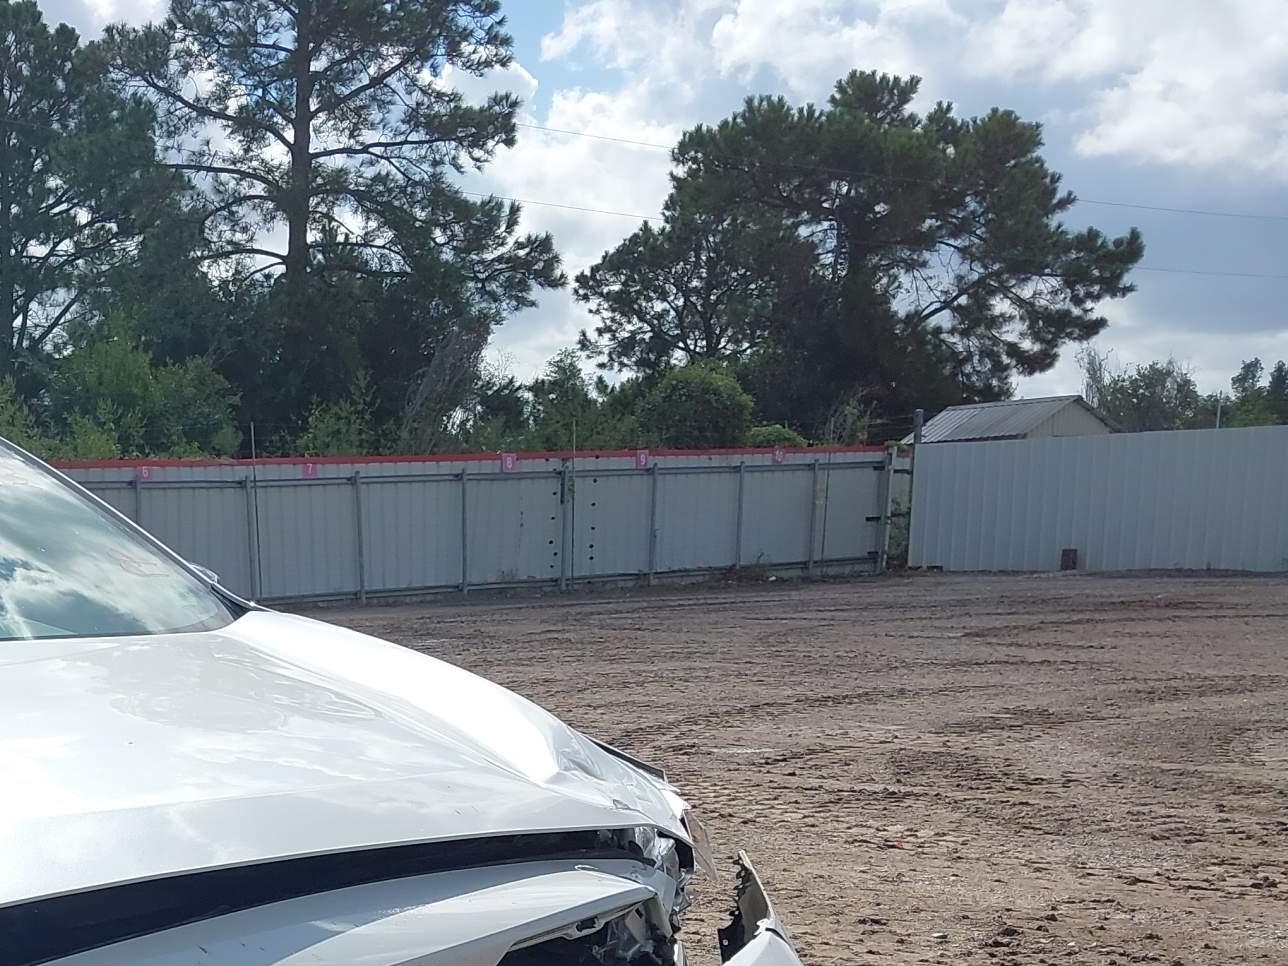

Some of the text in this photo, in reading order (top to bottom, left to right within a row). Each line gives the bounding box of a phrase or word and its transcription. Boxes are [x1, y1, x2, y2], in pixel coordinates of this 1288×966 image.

[506, 456, 513, 469] 8
[640, 454, 646, 465] 9
[306, 463, 313, 474] 7
